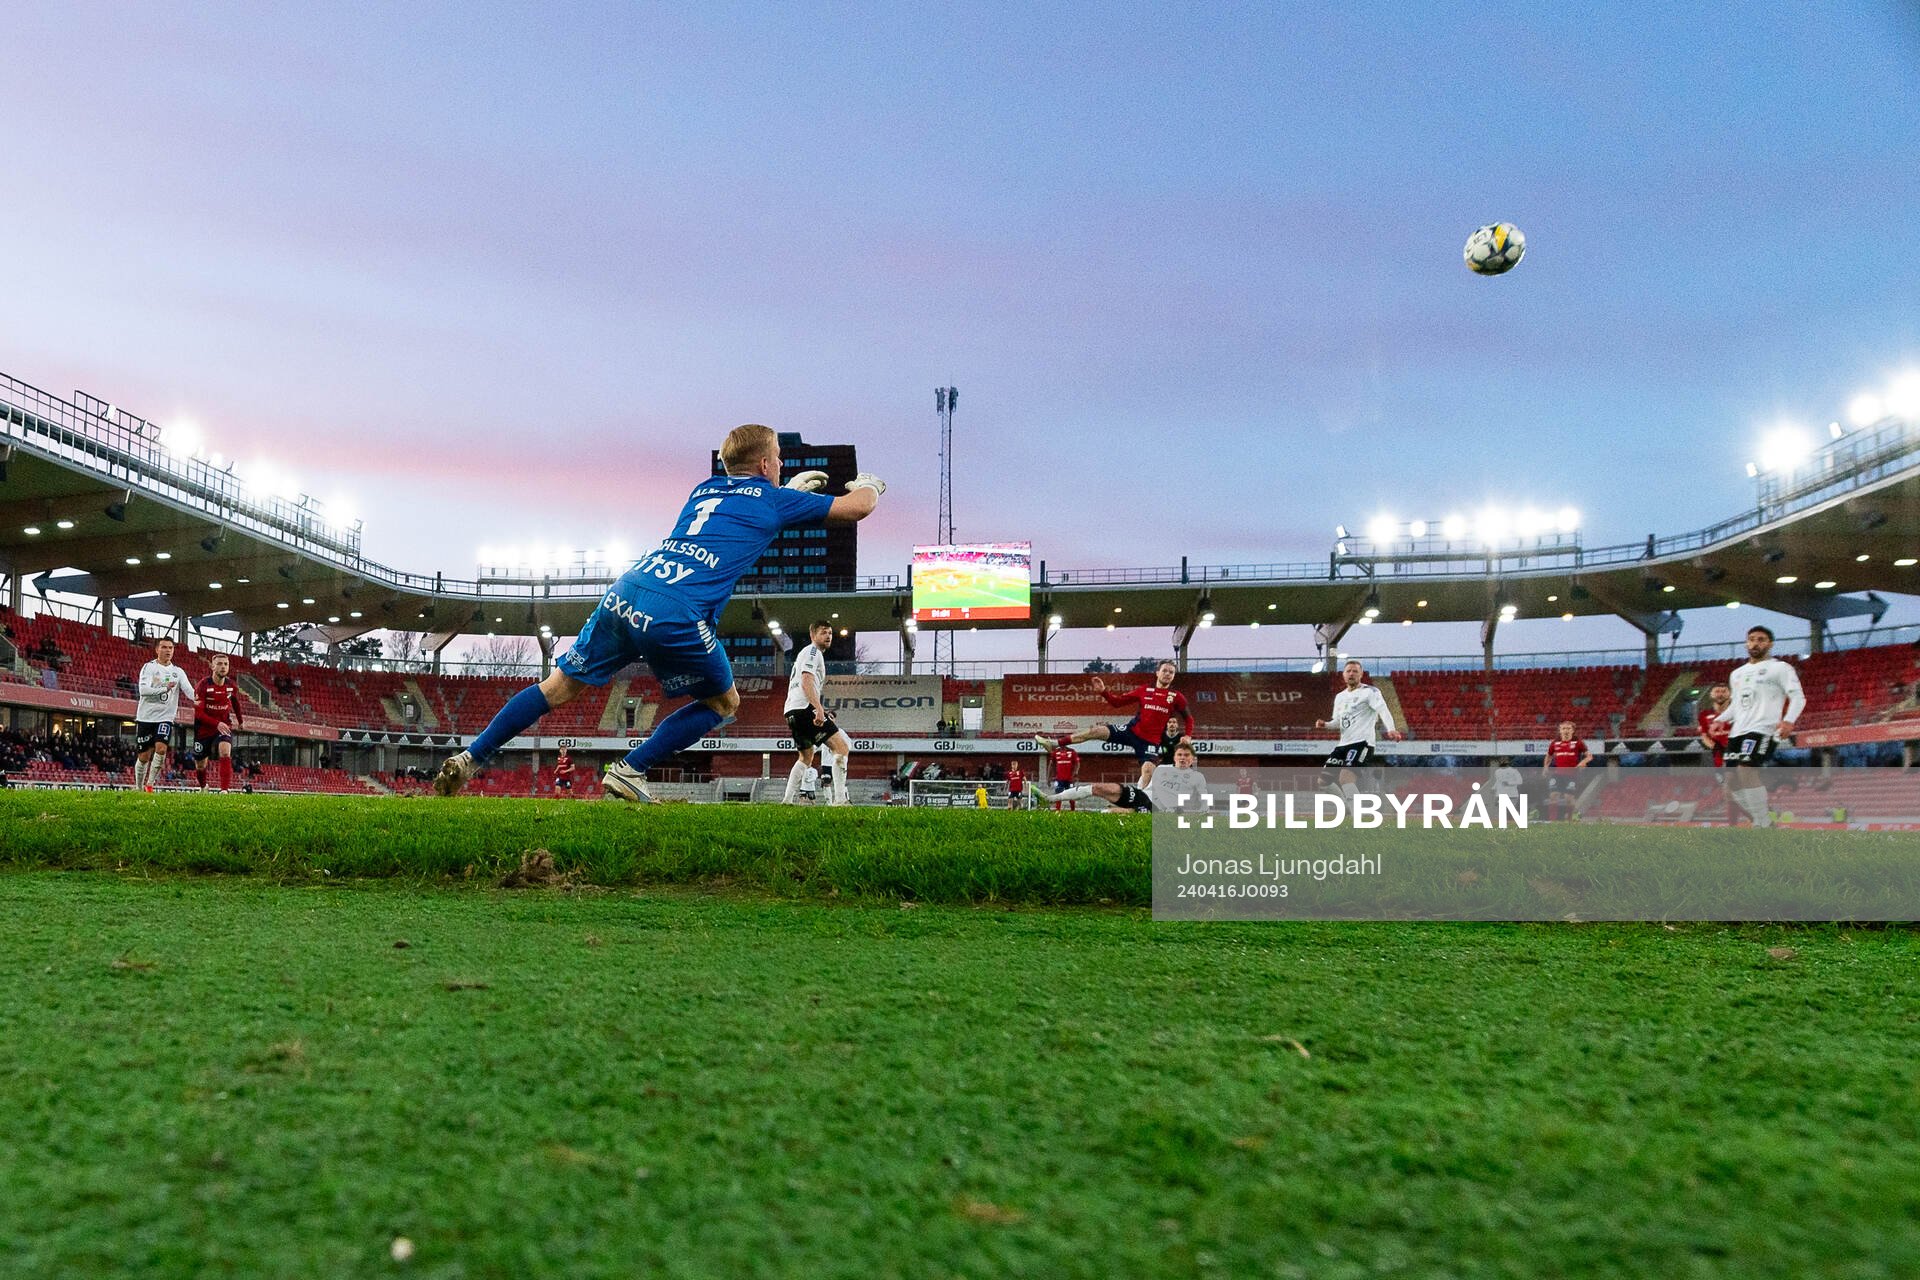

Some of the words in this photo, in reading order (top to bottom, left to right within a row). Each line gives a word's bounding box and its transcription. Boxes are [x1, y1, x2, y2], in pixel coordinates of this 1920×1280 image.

[685, 497, 724, 536] 1
[660, 539, 720, 569] HLSSON
[603, 591, 653, 632] EXACT
[1012, 683, 1046, 692] Dina
[1050, 682, 1141, 692] ICA-hndlar
[1224, 691, 1248, 702] LF
[1256, 691, 1303, 702] CUP
[820, 694, 935, 711] ynacon
[557, 738, 577, 748] GBJ
[628, 739, 646, 748] GB
[701, 739, 721, 749] GBJ
[776, 739, 797, 749] GBJ
[854, 740, 875, 750] GBJ
[934, 741, 955, 751] GBJ
[1016, 741, 1038, 751] GBJ
[1191, 742, 1214, 752] GBJ
